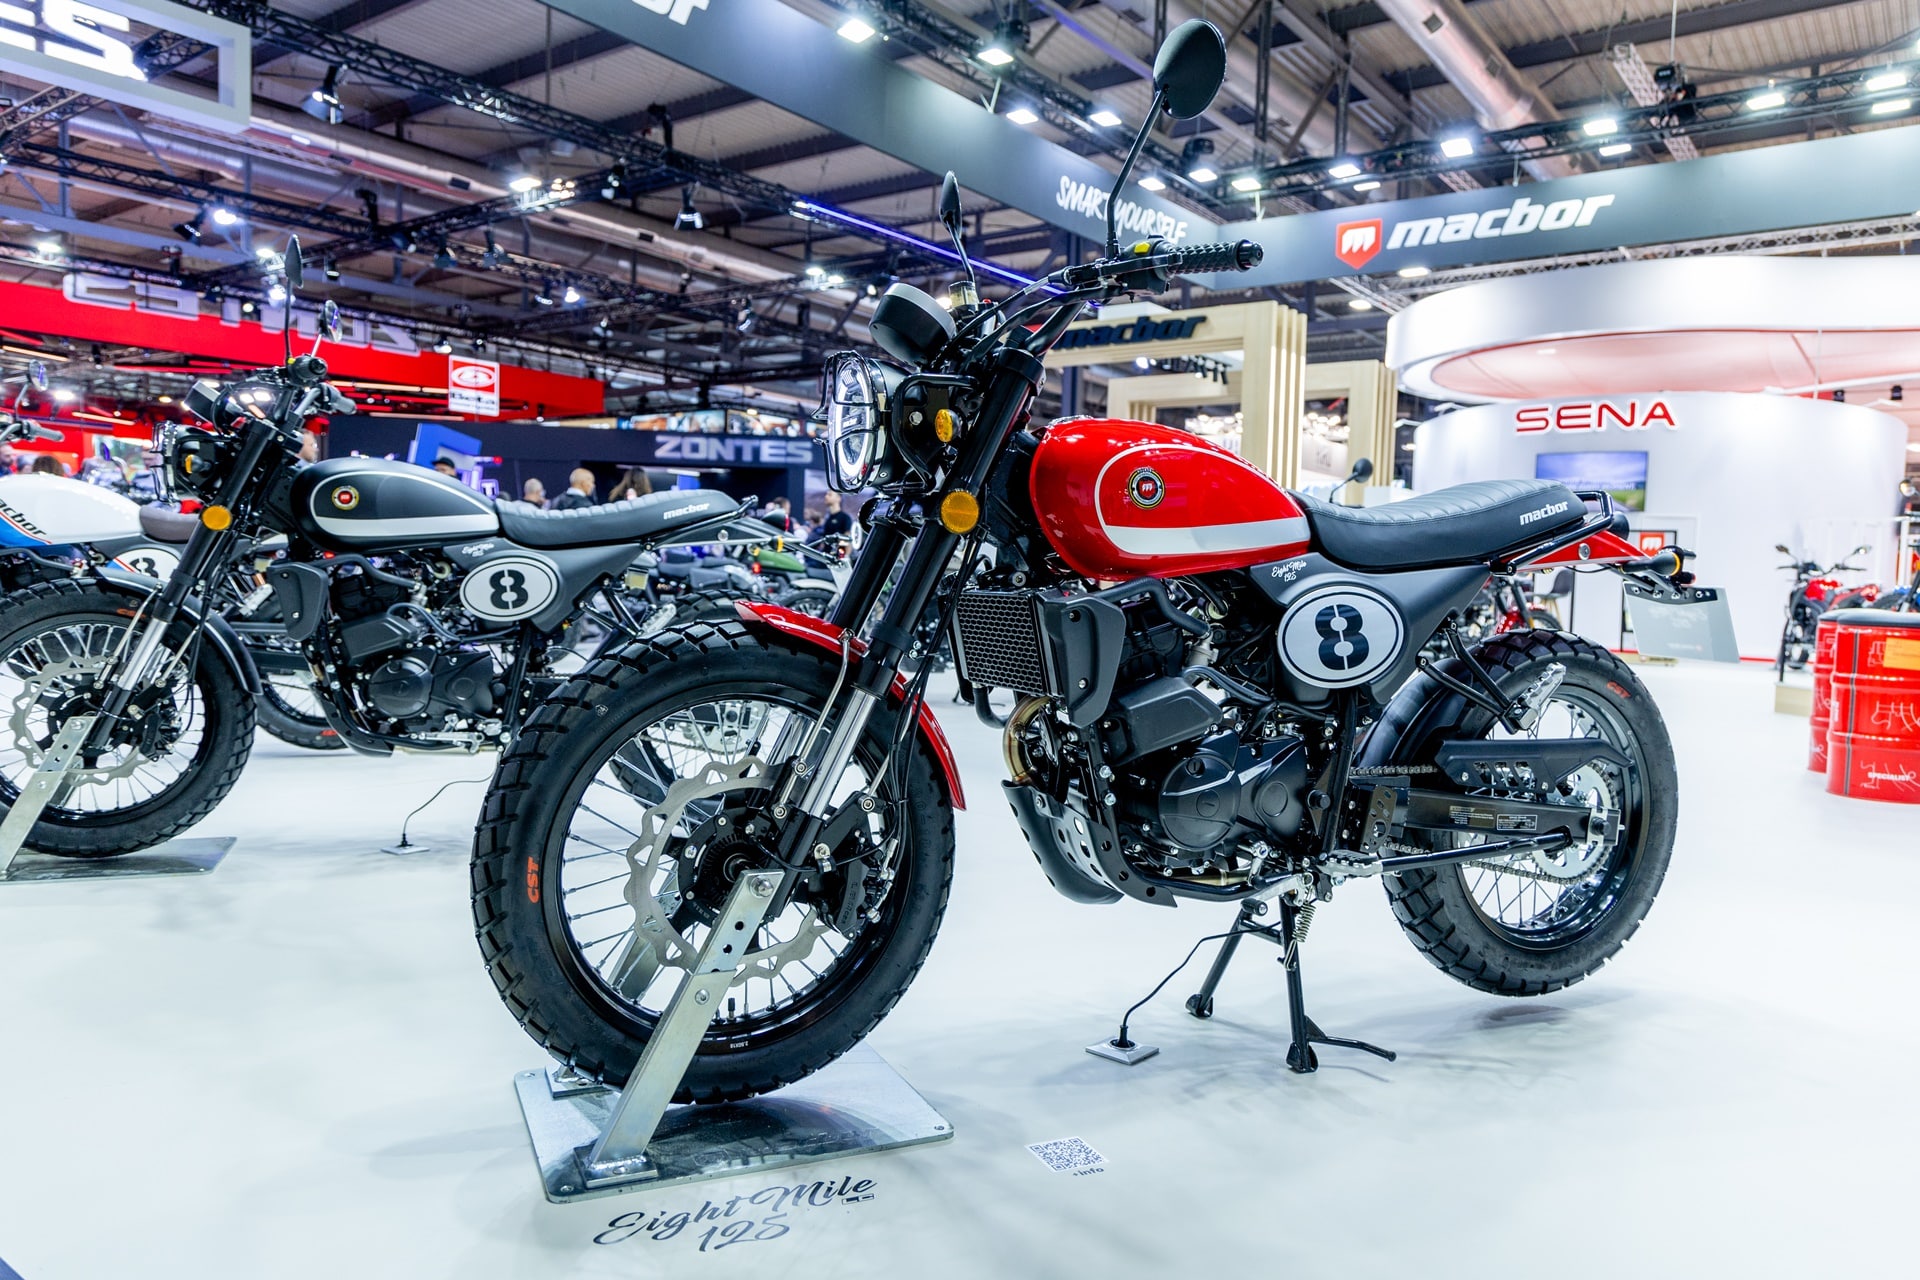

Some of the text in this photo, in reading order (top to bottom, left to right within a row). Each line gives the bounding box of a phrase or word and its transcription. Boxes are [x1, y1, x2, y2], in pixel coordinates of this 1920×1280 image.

[1386, 194, 1616, 250] macbor
[1515, 401, 1676, 433] SENA
[654, 434, 813, 464] ZONTES
[663, 502, 711, 520] macbor
[1519, 500, 1569, 526] macbor
[489, 569, 529, 610] 8
[1271, 565, 1290, 578] Eight
[1283, 571, 1297, 582] 125
[1314, 604, 1370, 671] 8
[527, 856, 540, 903] CST
[592, 1175, 877, 1245] Eight Mile
[699, 1212, 790, 1252] 125
